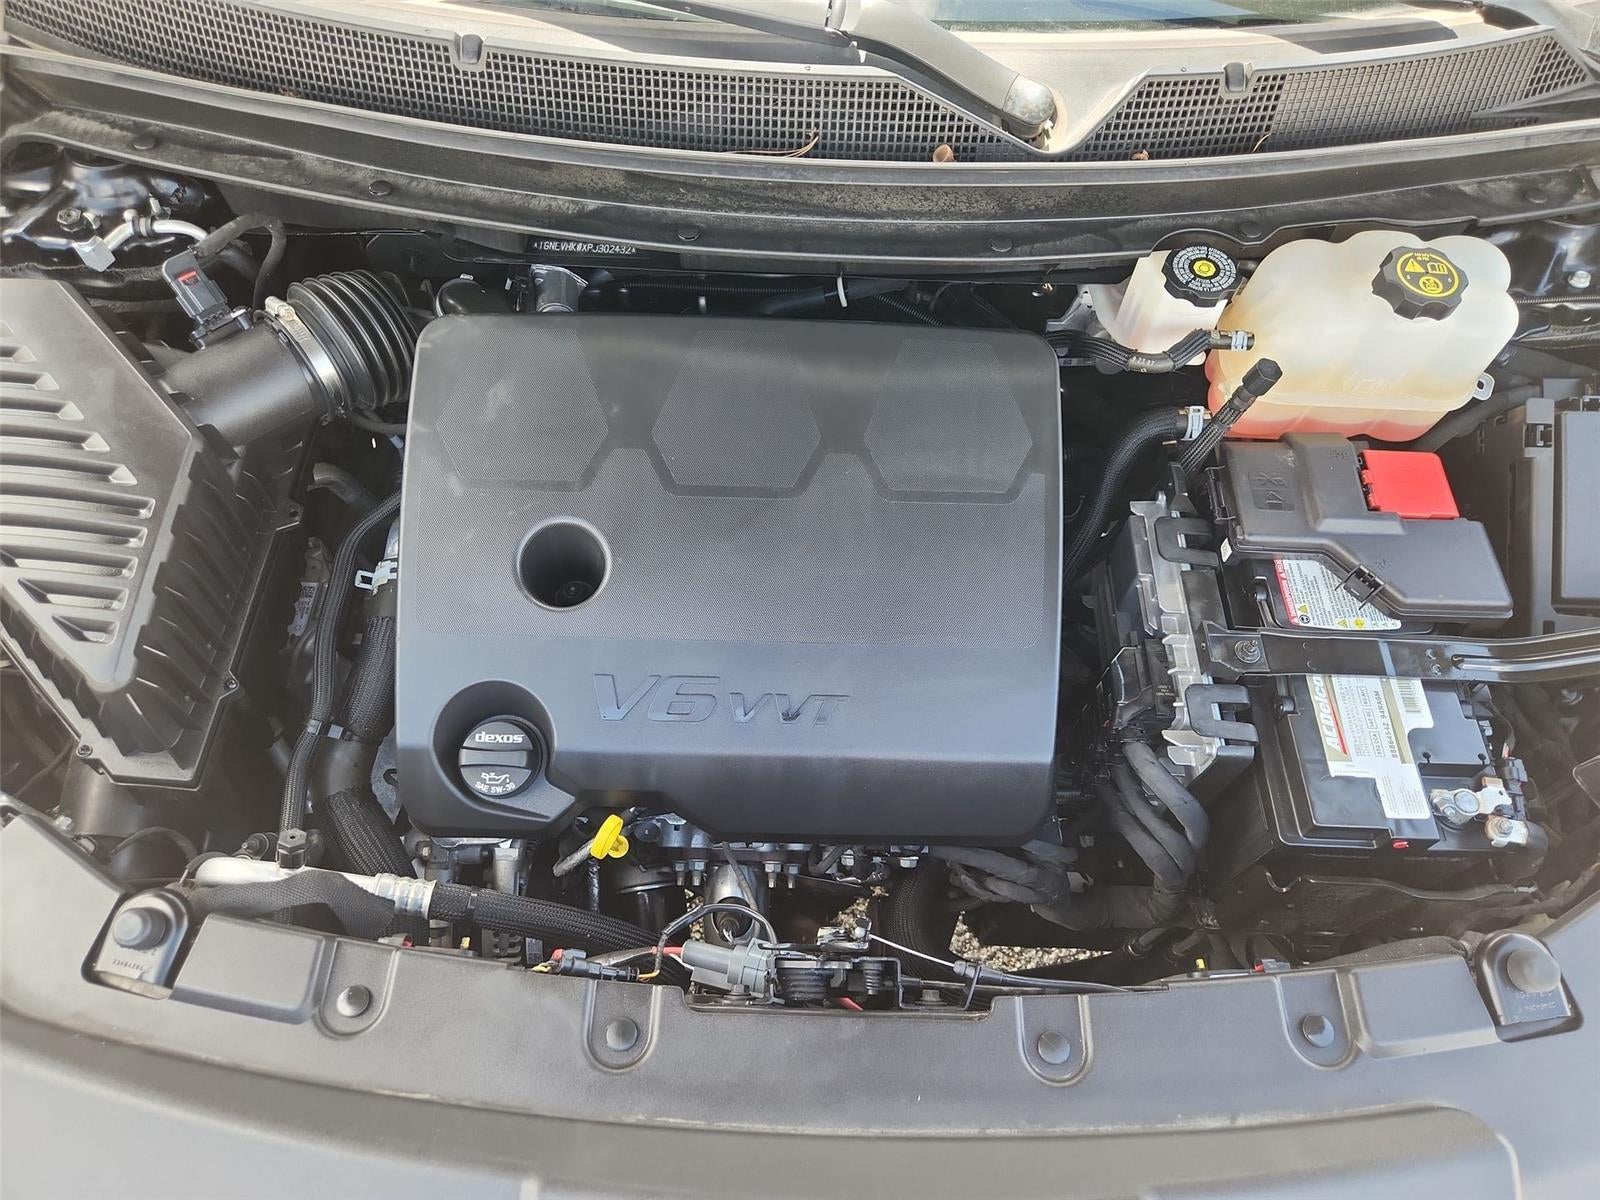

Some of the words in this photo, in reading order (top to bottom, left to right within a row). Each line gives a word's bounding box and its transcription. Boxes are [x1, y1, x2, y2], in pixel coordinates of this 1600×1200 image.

[593, 673, 720, 722] V6
[728, 692, 850, 727] VVT
[475, 731, 526, 744] dexos
[475, 781, 490, 793] SAE
[490, 782, 516, 794] 5W-30
